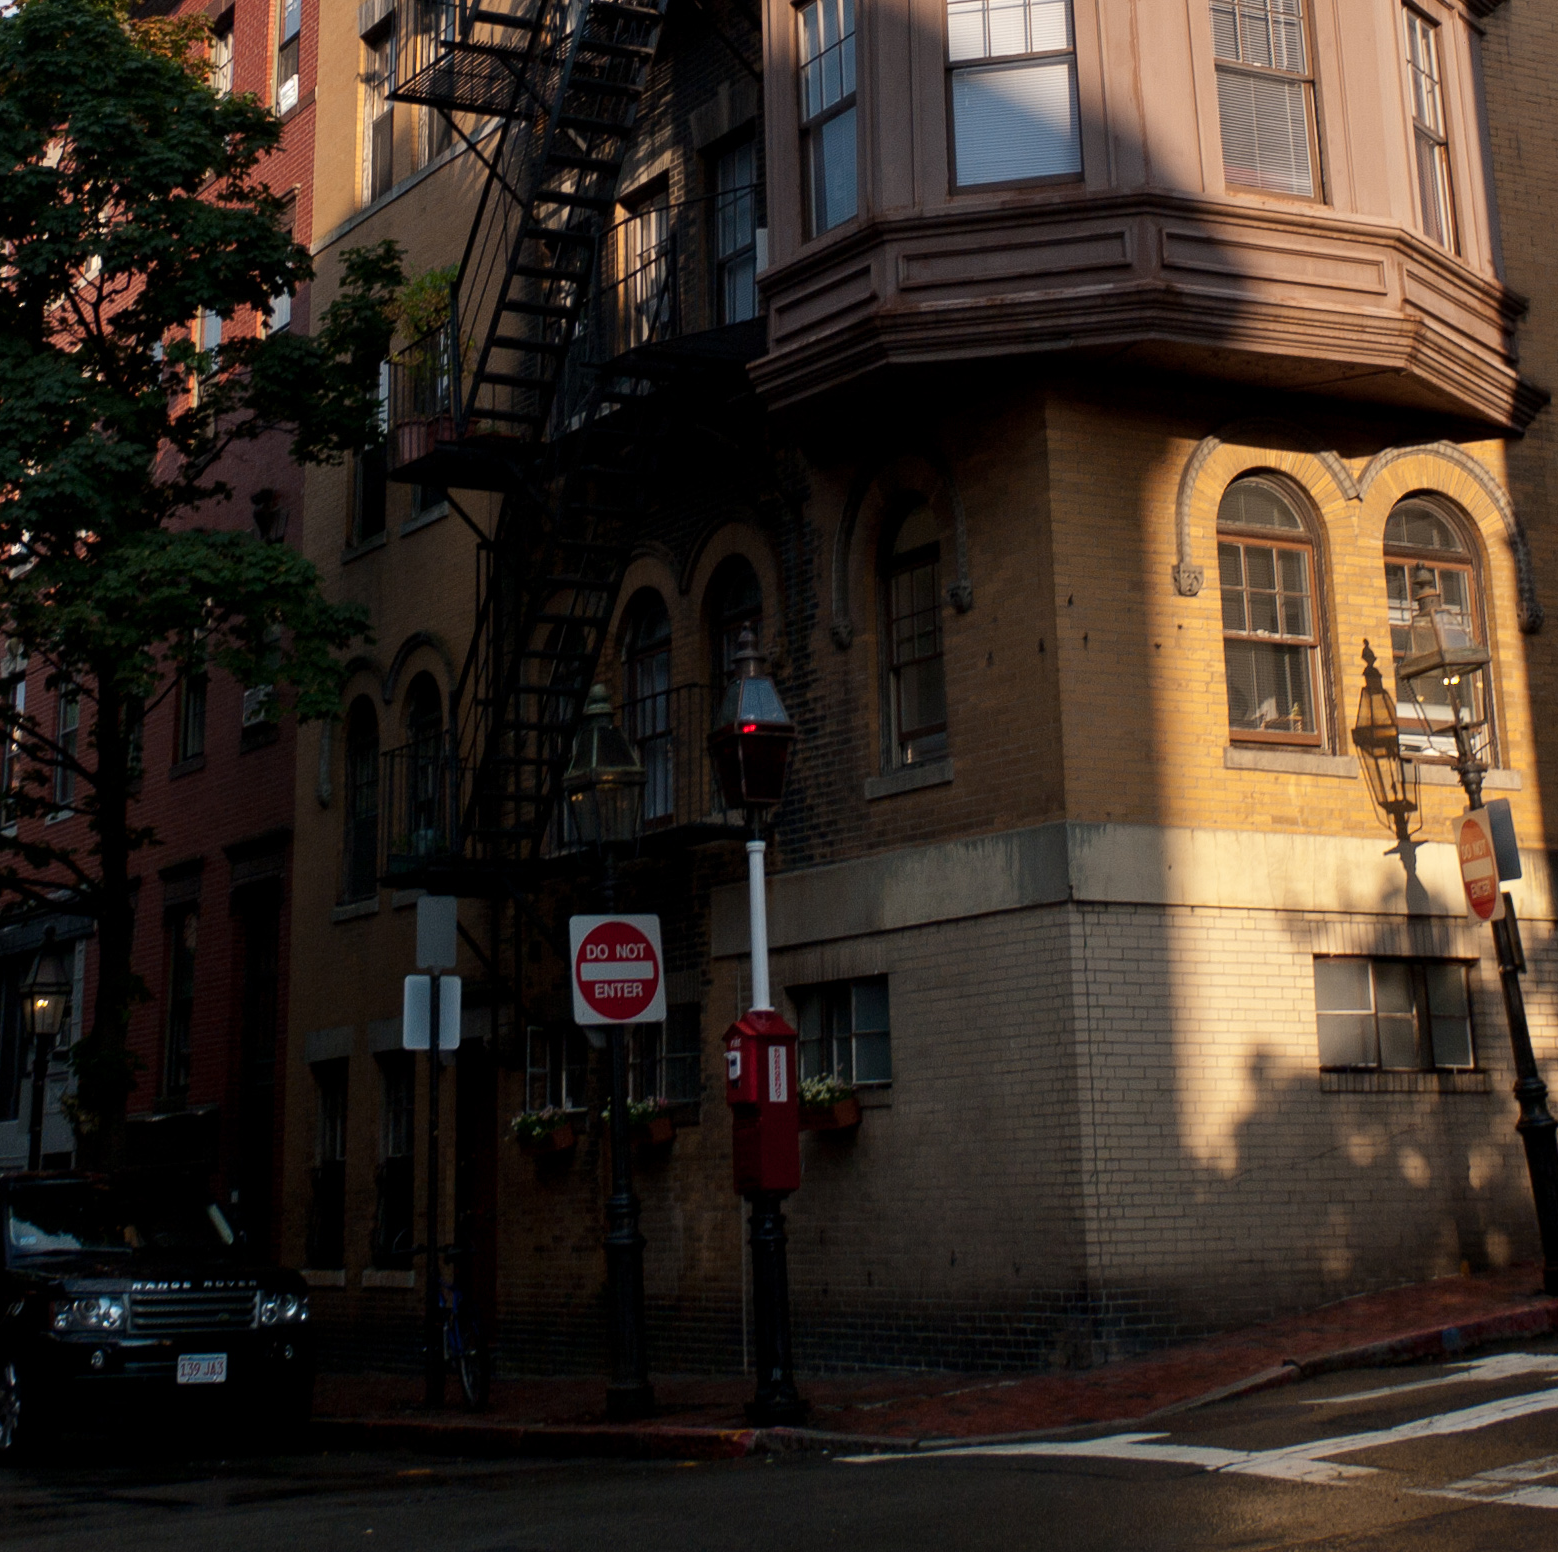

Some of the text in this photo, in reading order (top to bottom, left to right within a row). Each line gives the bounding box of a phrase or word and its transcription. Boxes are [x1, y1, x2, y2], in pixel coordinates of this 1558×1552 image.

[1463, 840, 1486, 860] DO NOT
[1471, 880, 1490, 898] ENTER
[586, 943, 646, 960] DO NOT
[595, 982, 643, 999] ENTER
[131, 1280, 258, 1291] RANGE ROVER
